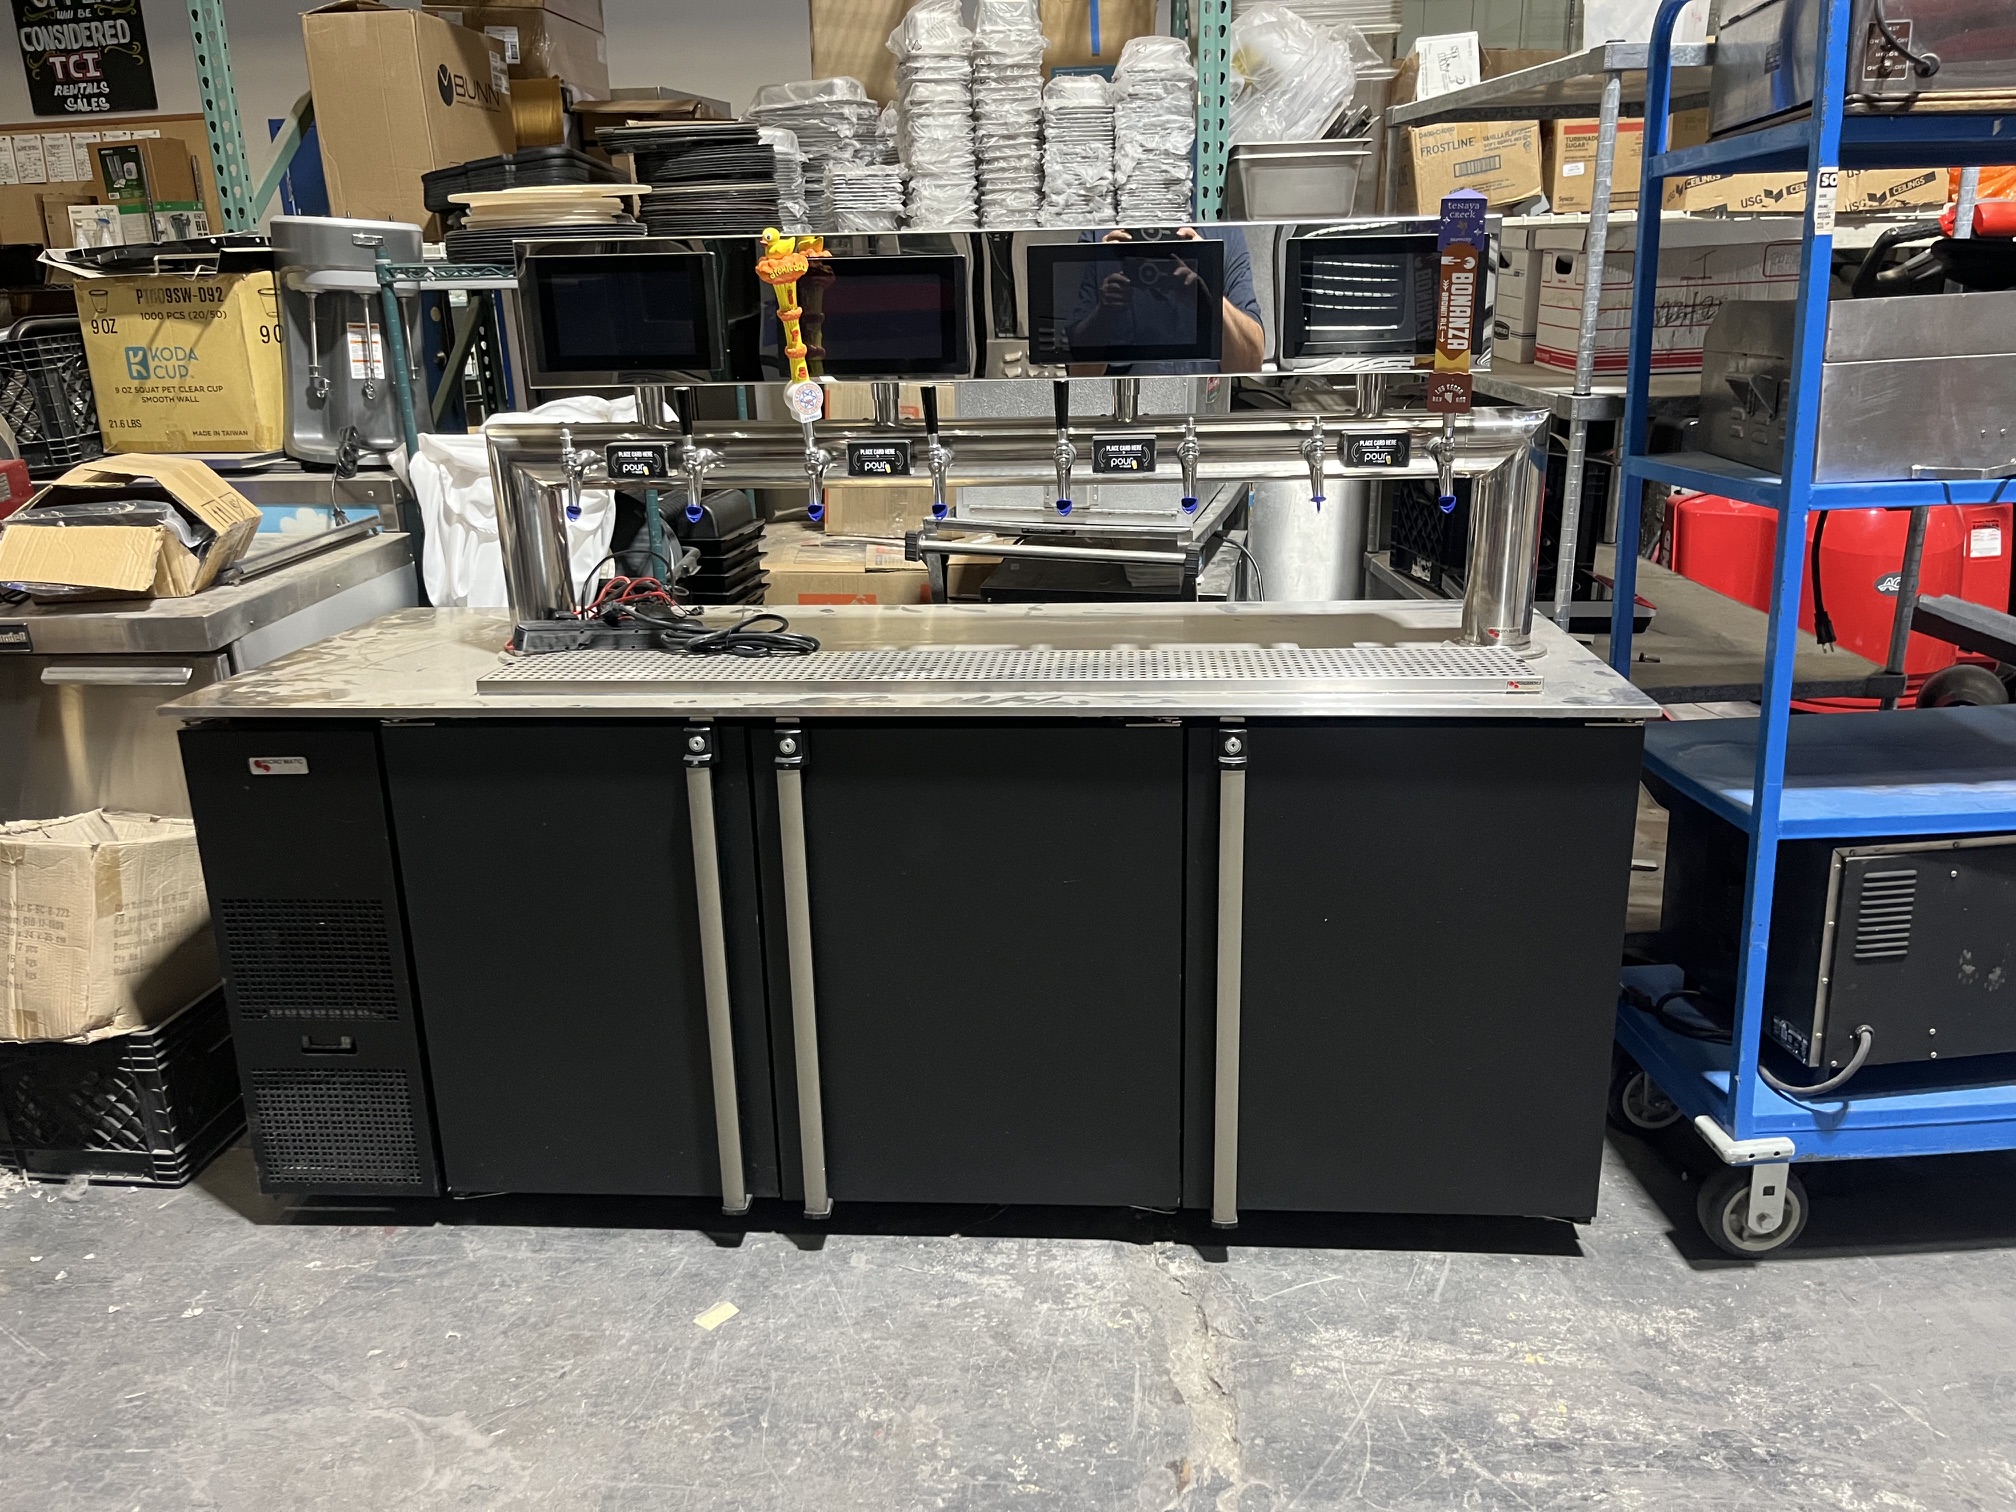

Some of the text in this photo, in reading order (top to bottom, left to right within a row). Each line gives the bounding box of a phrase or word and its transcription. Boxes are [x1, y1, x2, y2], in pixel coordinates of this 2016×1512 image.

[77, 9, 92, 18] BE
[20, 19, 131, 52] CONSIDERED
[48, 52, 101, 80] TCI
[54, 81, 110, 97] RENTALS
[453, 74, 500, 106] BUNN
[64, 97, 110, 112] SALES
[1420, 139, 1475, 157] FROSTLINE
[1892, 176, 1926, 195] CEILINGS
[1740, 194, 1763, 209] USG
[141, 310, 227, 321] 1000 PCS (20/50)
[1447, 272, 1474, 350] BONANZA
[91, 318, 118, 335] 9 OZ
[259, 325, 271, 344] 9
[150, 346, 199, 362] KODA
[153, 364, 189, 380] CUP
[134, 386, 159, 394] SQUAT
[108, 419, 142, 429] 21.6 LBS
[1110, 457, 1133, 467] pour
[1364, 452, 1388, 462] pour
[622, 463, 644, 473] pour
[864, 461, 887, 471] pour
